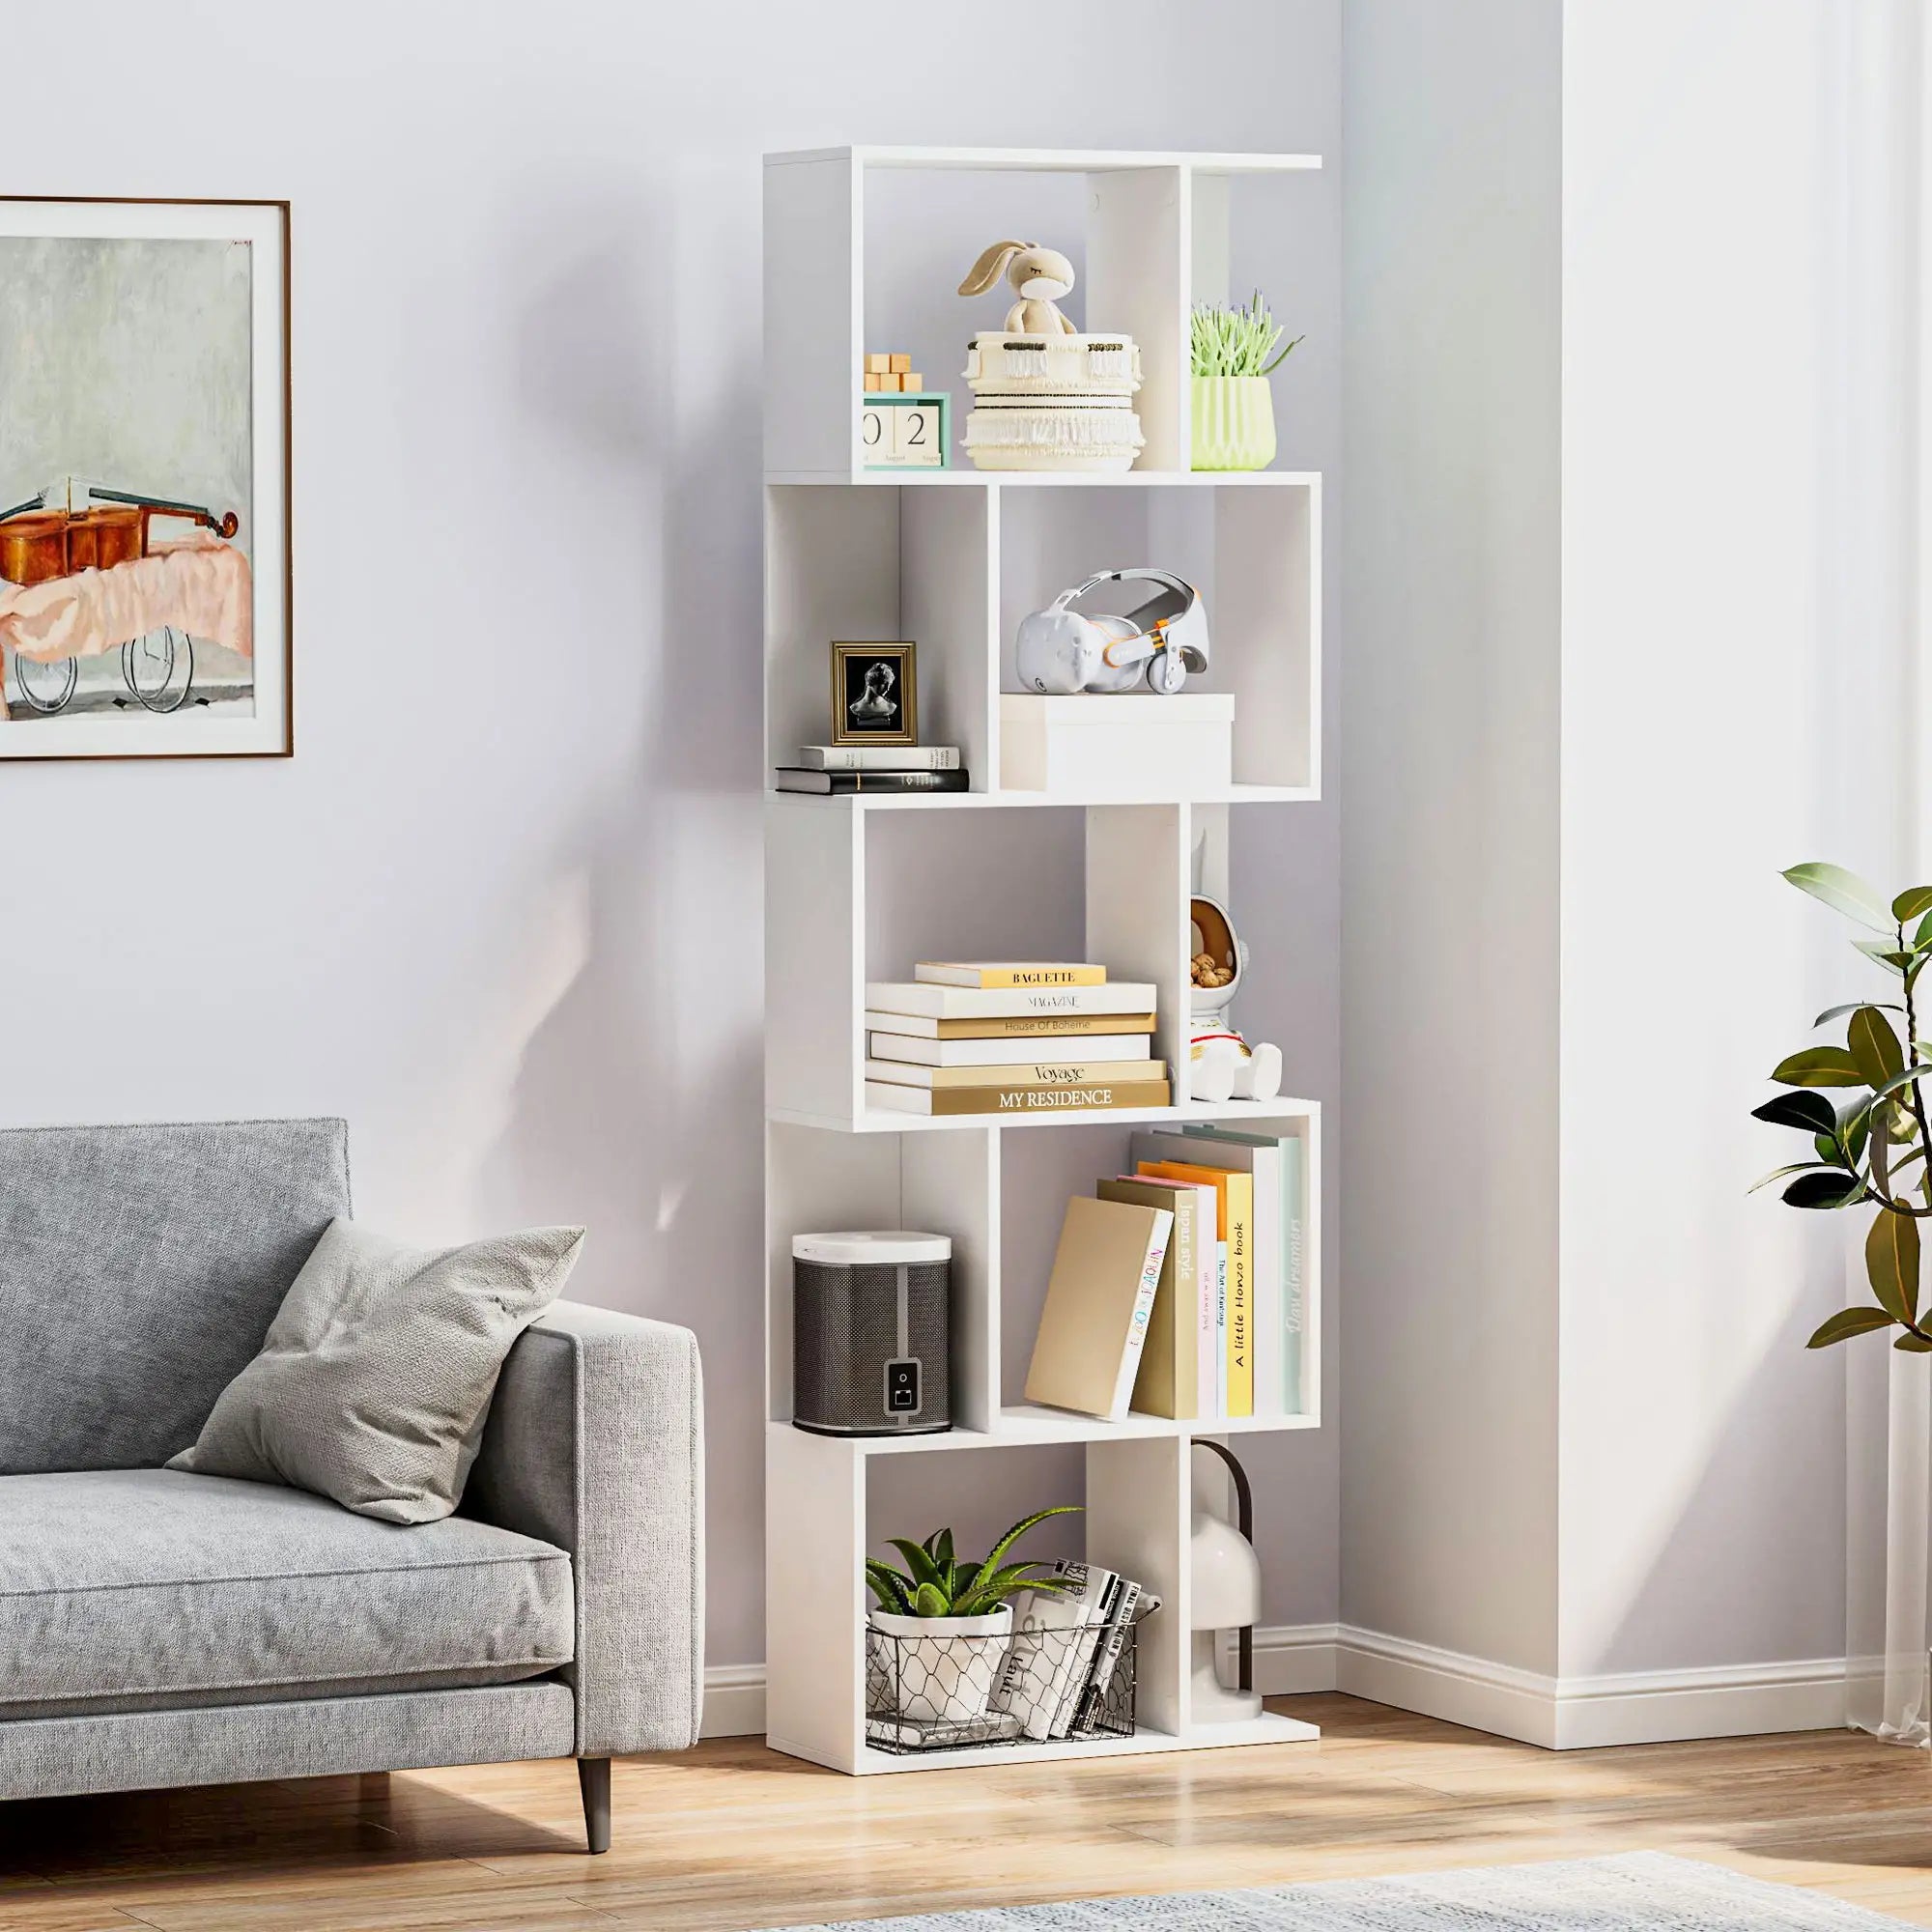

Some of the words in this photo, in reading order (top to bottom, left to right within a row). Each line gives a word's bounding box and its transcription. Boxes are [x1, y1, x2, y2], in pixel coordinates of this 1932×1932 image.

[1012, 972, 1076, 983] BAGUETTE
[1028, 995, 1079, 1009] MAGAZINE
[1005, 1020, 1036, 1032] House
[1037, 1019, 1050, 1031] Of
[1052, 1018, 1091, 1030] Boheme
[1035, 1065, 1086, 1083] Voyage
[999, 1093, 1025, 1109] MY
[1027, 1090, 1113, 1107] RESIDENCE
[1179, 1204, 1195, 1244] Japan
[1234, 1222, 1244, 1256] book
[1180, 1247, 1195, 1280] style
[1283, 1217, 1302, 1293] dreamers
[1235, 1262, 1244, 1308] Honzo
[1216, 1296, 1226, 1327] Kintsugi
[1235, 1315, 1244, 1350] little
[1236, 1355, 1244, 1367] A
[999, 1656, 1024, 1695] Laut
